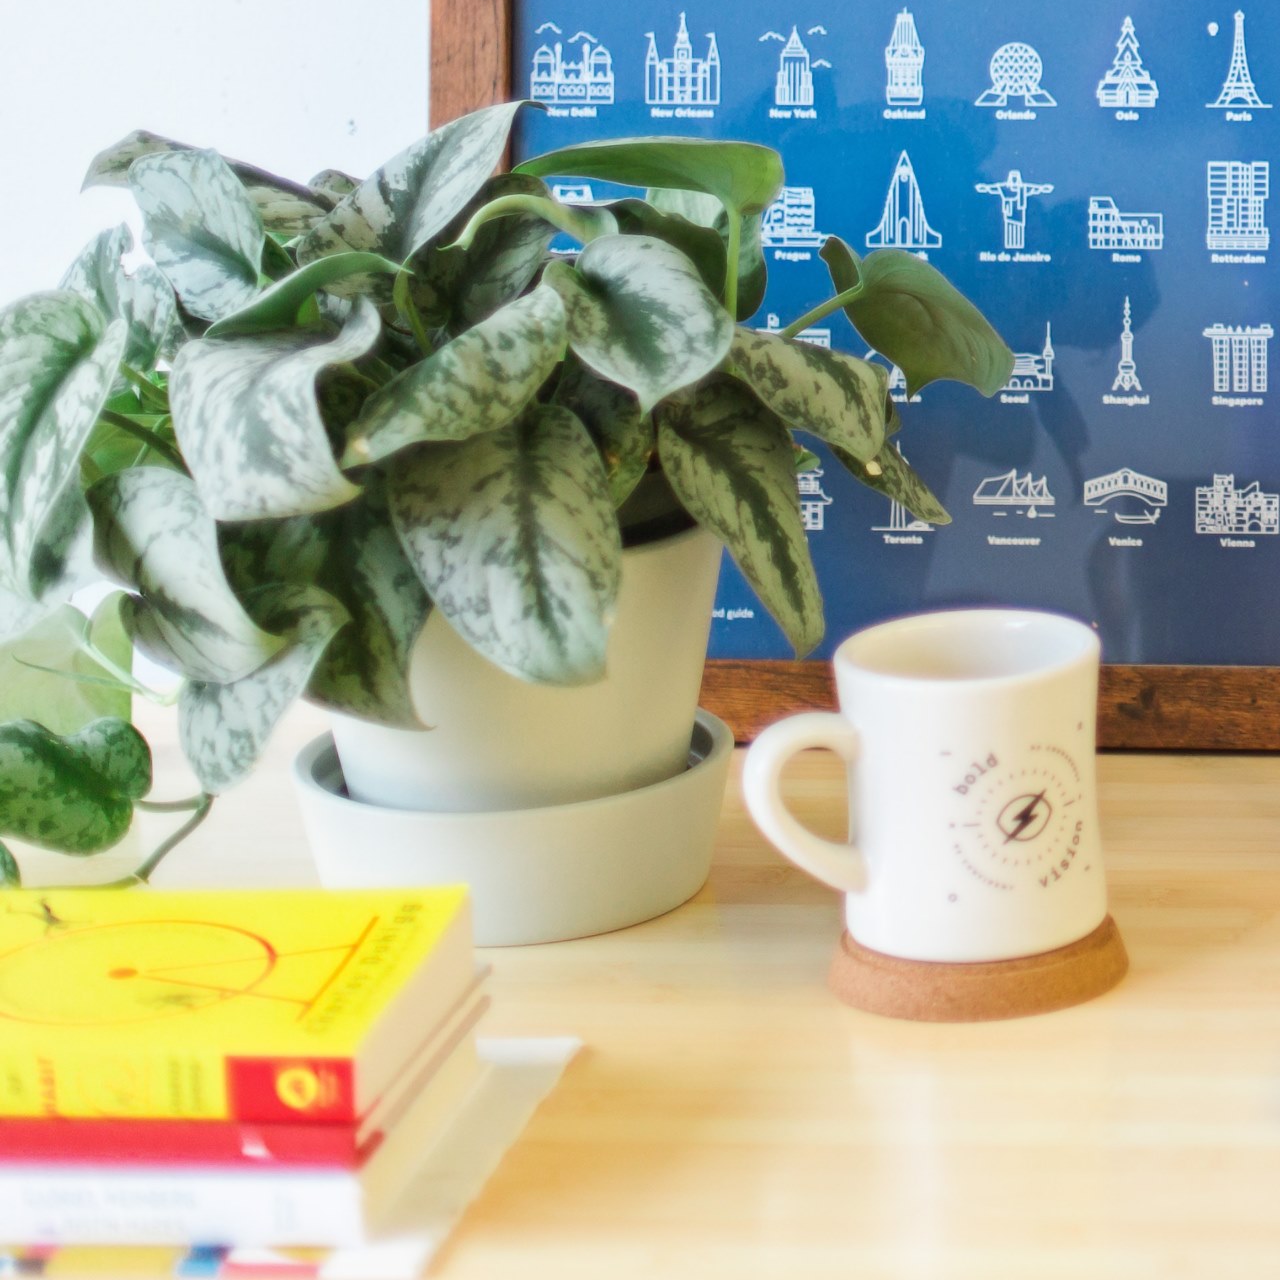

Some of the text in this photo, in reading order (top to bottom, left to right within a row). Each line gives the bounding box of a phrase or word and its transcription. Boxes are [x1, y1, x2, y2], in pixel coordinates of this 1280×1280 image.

[571, 106, 597, 117] Delhi
[651, 107, 714, 118] New Orleans
[769, 108, 817, 118] New York
[883, 109, 925, 119] Oakland
[995, 109, 1036, 120] Orlando
[1115, 111, 1139, 120] Oslo
[1226, 111, 1252, 121] Paris
[775, 250, 811, 261] Prague
[979, 252, 1051, 262] Rio de Janeiro
[1112, 253, 1141, 262] Rome
[1211, 254, 1265, 263] Rotterdam
[1001, 393, 1029, 403] Seoul
[1103, 395, 1149, 406] Shanghai
[1212, 396, 1263, 407] Singapore
[883, 534, 923, 544] Toronto
[988, 536, 1040, 545] Vancouver
[1109, 537, 1142, 546] Venice
[1220, 538, 1255, 547] Vienna
[727, 607, 754, 621] guide
[952, 752, 999, 796] bold
[1038, 820, 1083, 888] vision
